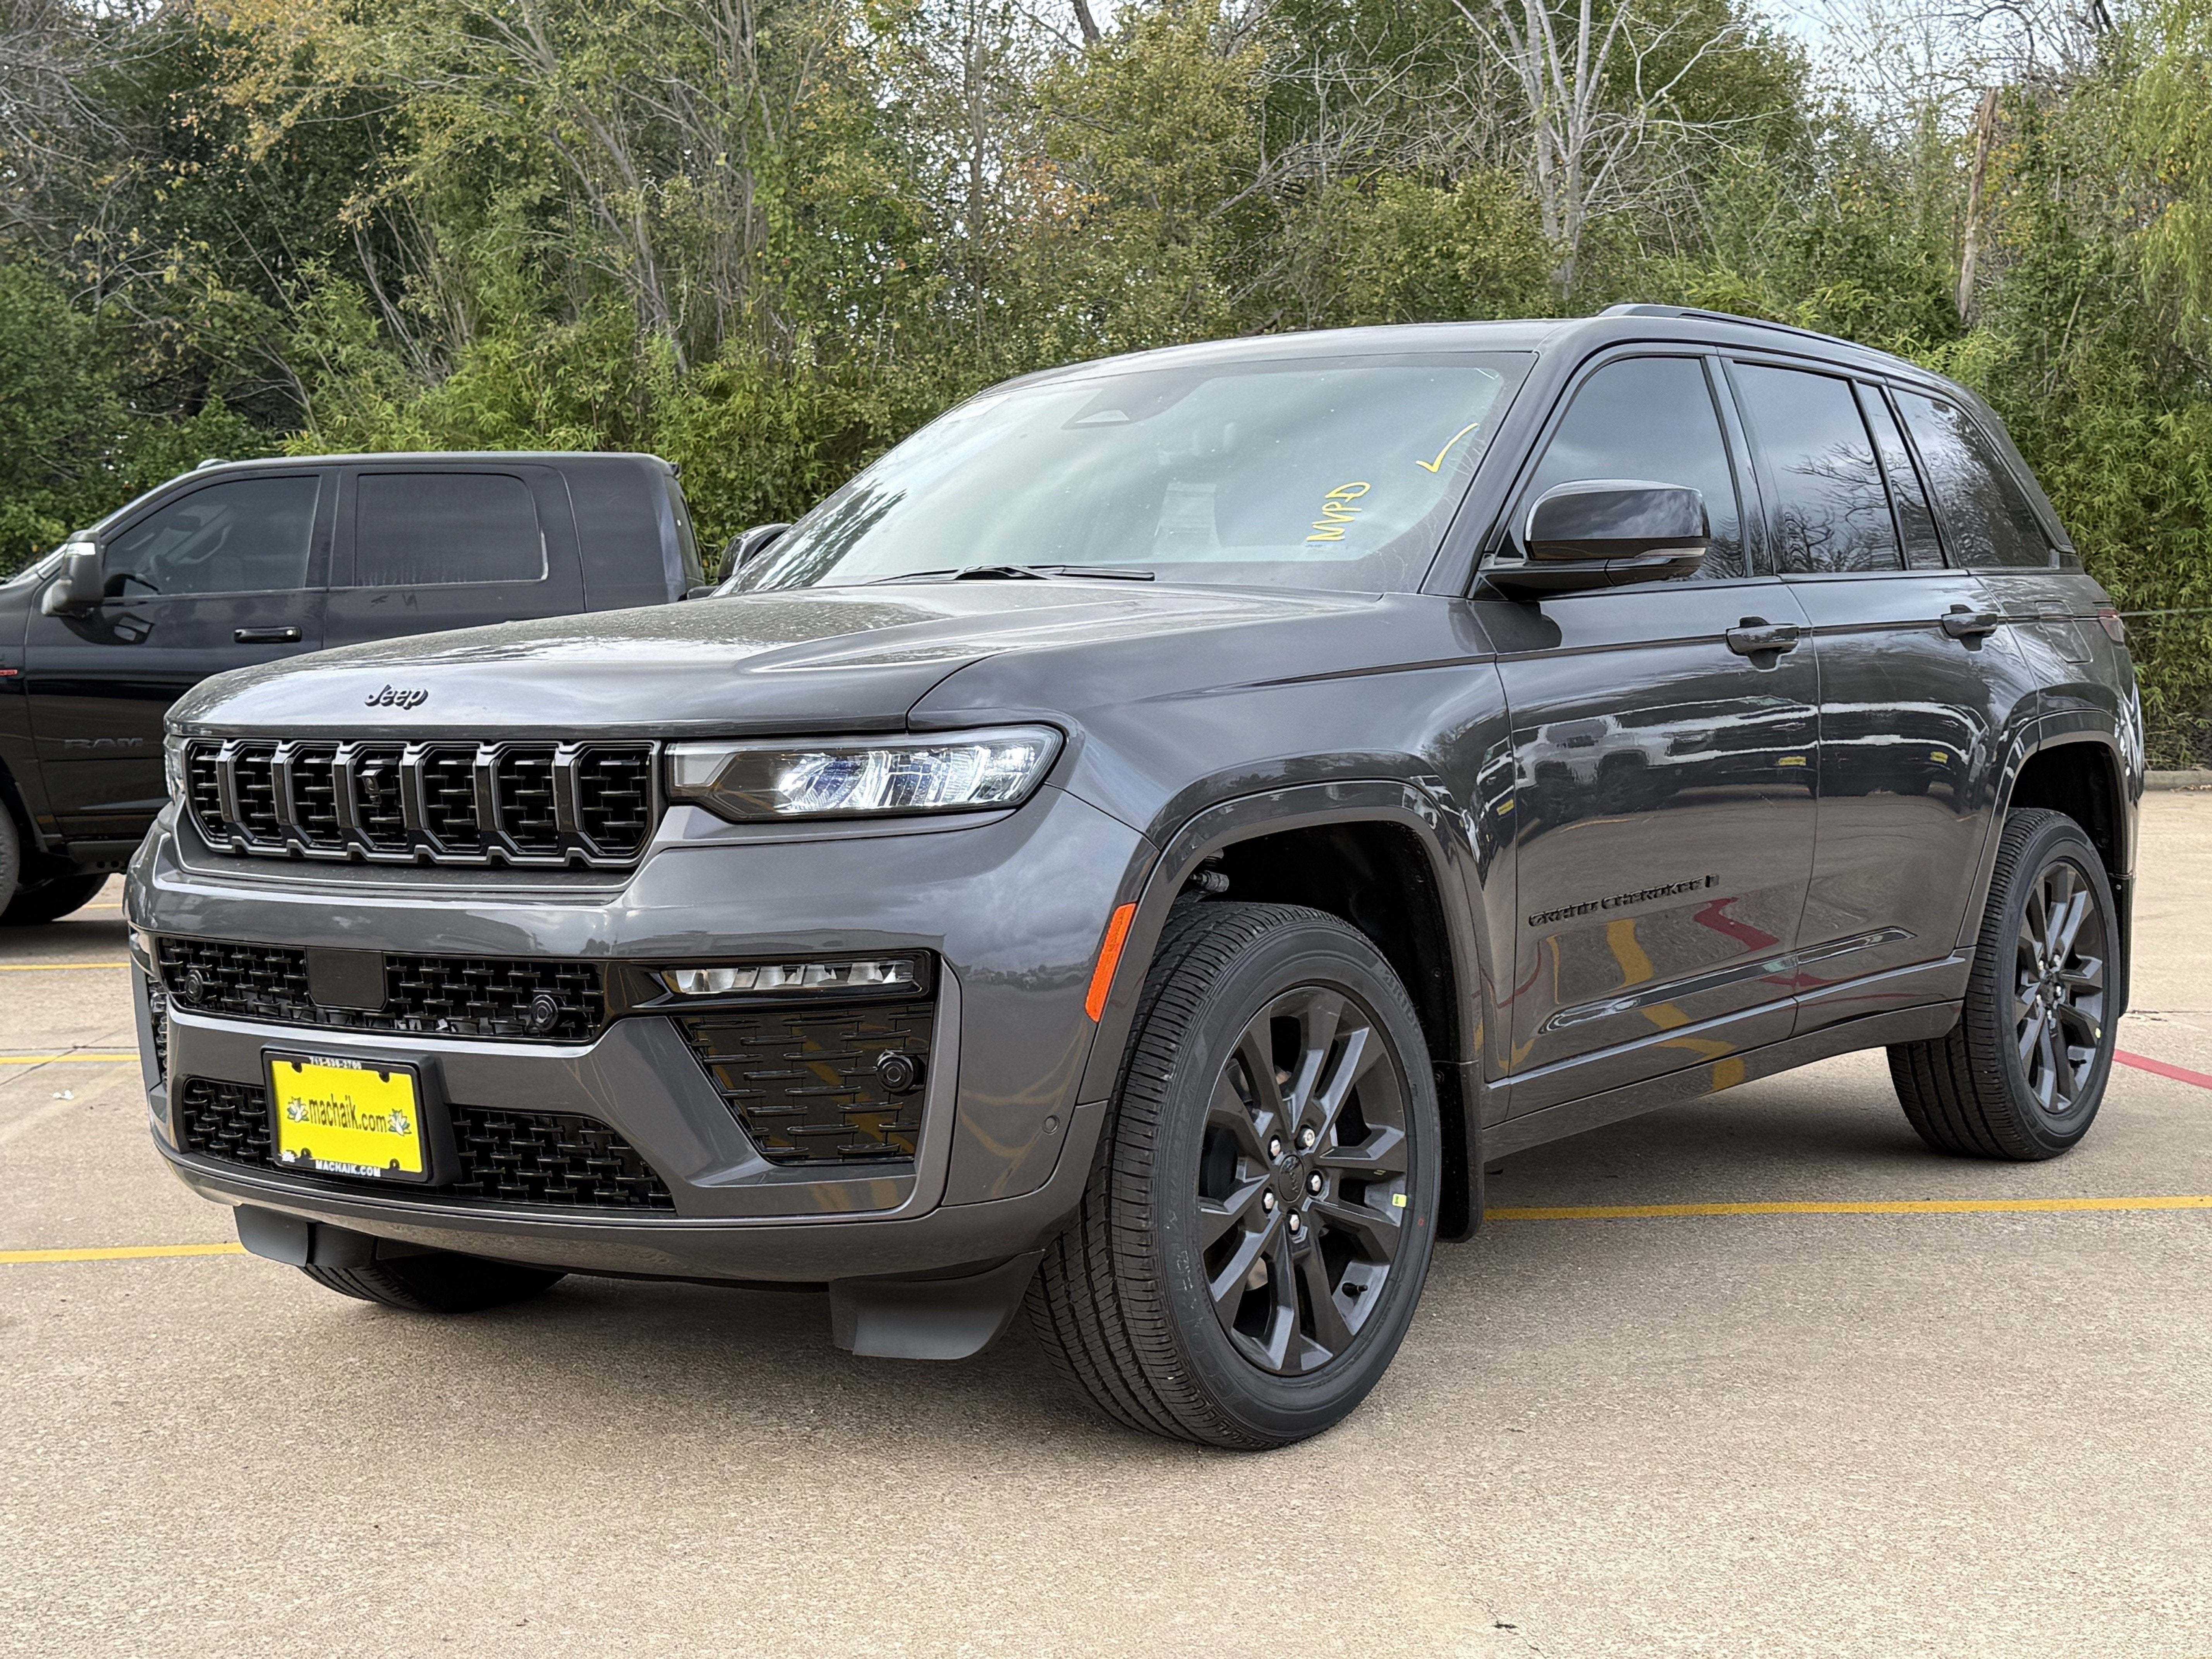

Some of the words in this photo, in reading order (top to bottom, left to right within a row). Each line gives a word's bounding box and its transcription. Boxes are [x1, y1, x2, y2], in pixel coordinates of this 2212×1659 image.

[364, 684, 428, 710] Jeep
[64, 738, 143, 749] RAM
[309, 1093, 386, 1133] machaik.com
[315, 1159, 381, 1178] MACHAIK.COM
